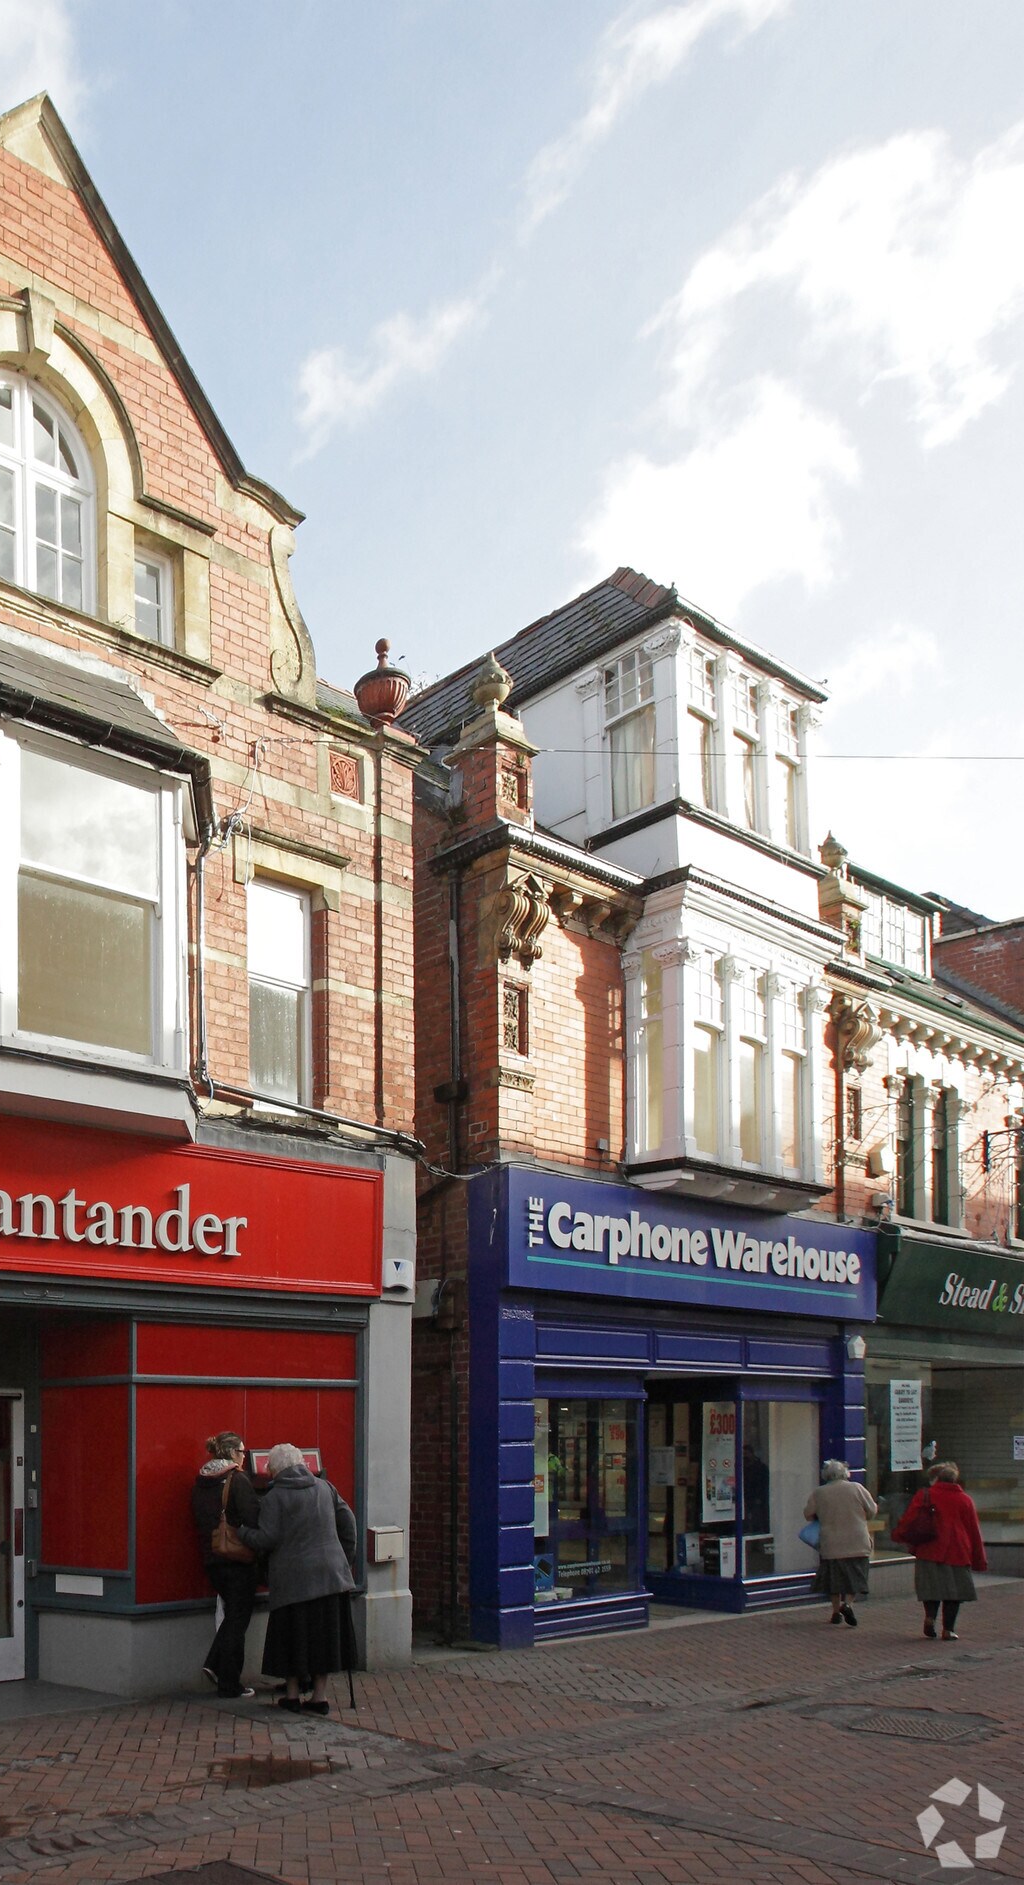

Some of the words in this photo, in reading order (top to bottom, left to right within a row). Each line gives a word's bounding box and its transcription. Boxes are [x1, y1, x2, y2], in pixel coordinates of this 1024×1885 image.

[529, 1196, 544, 1247] THE
[546, 1201, 709, 1265] Carphone
[710, 1227, 862, 1285] Warehouse
[939, 1272, 995, 1310] Stead
[992, 1283, 1008, 1312] &
[710, 1413, 735, 1435] £300
